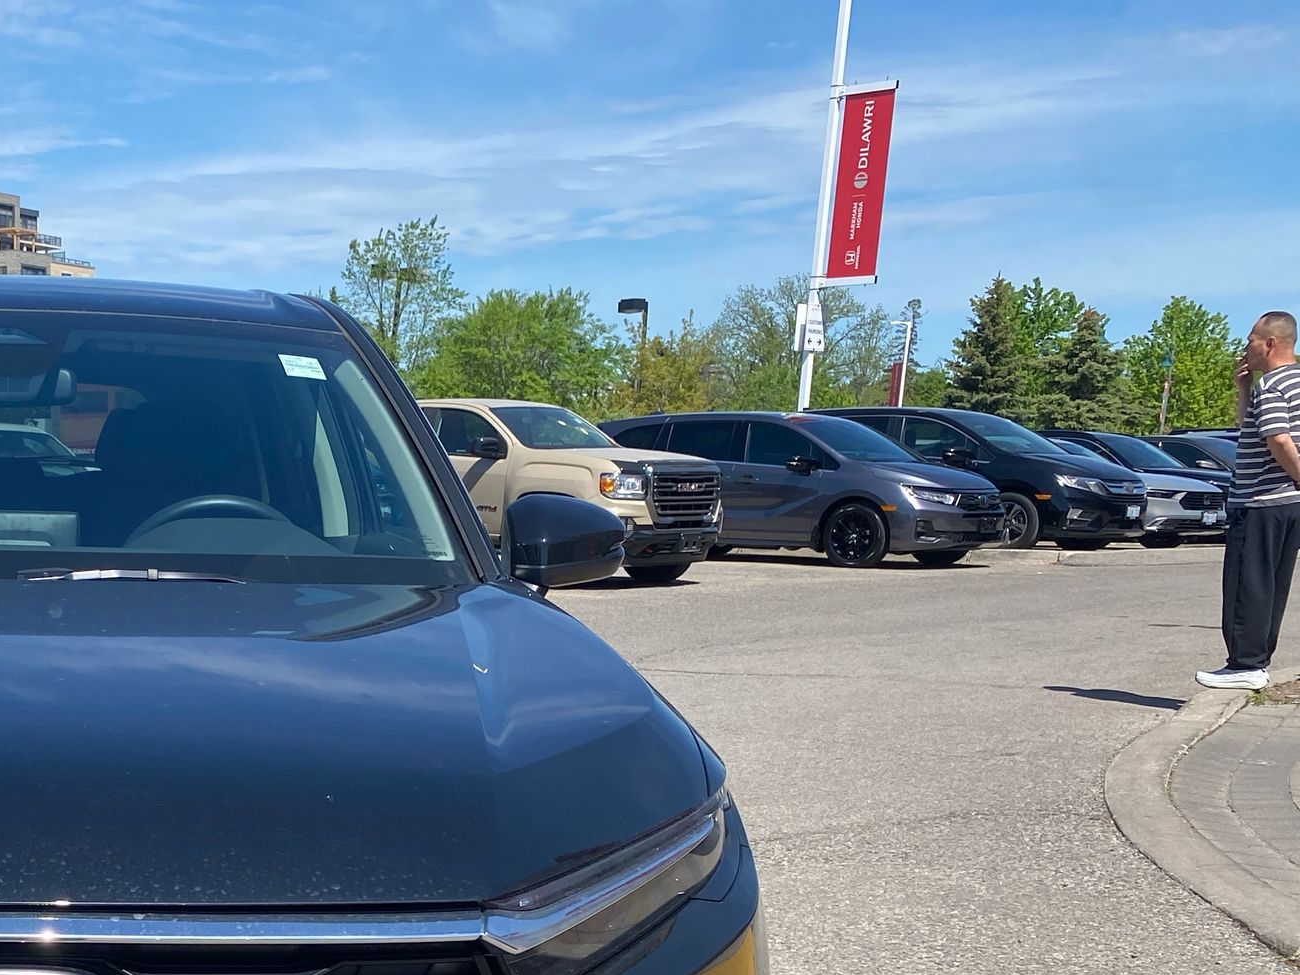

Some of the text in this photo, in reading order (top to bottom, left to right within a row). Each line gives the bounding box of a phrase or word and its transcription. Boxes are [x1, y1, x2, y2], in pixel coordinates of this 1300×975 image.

[858, 100, 875, 169] DILAWRI
[849, 202, 858, 240] MARKHAM
[856, 201, 864, 229] HONDA
